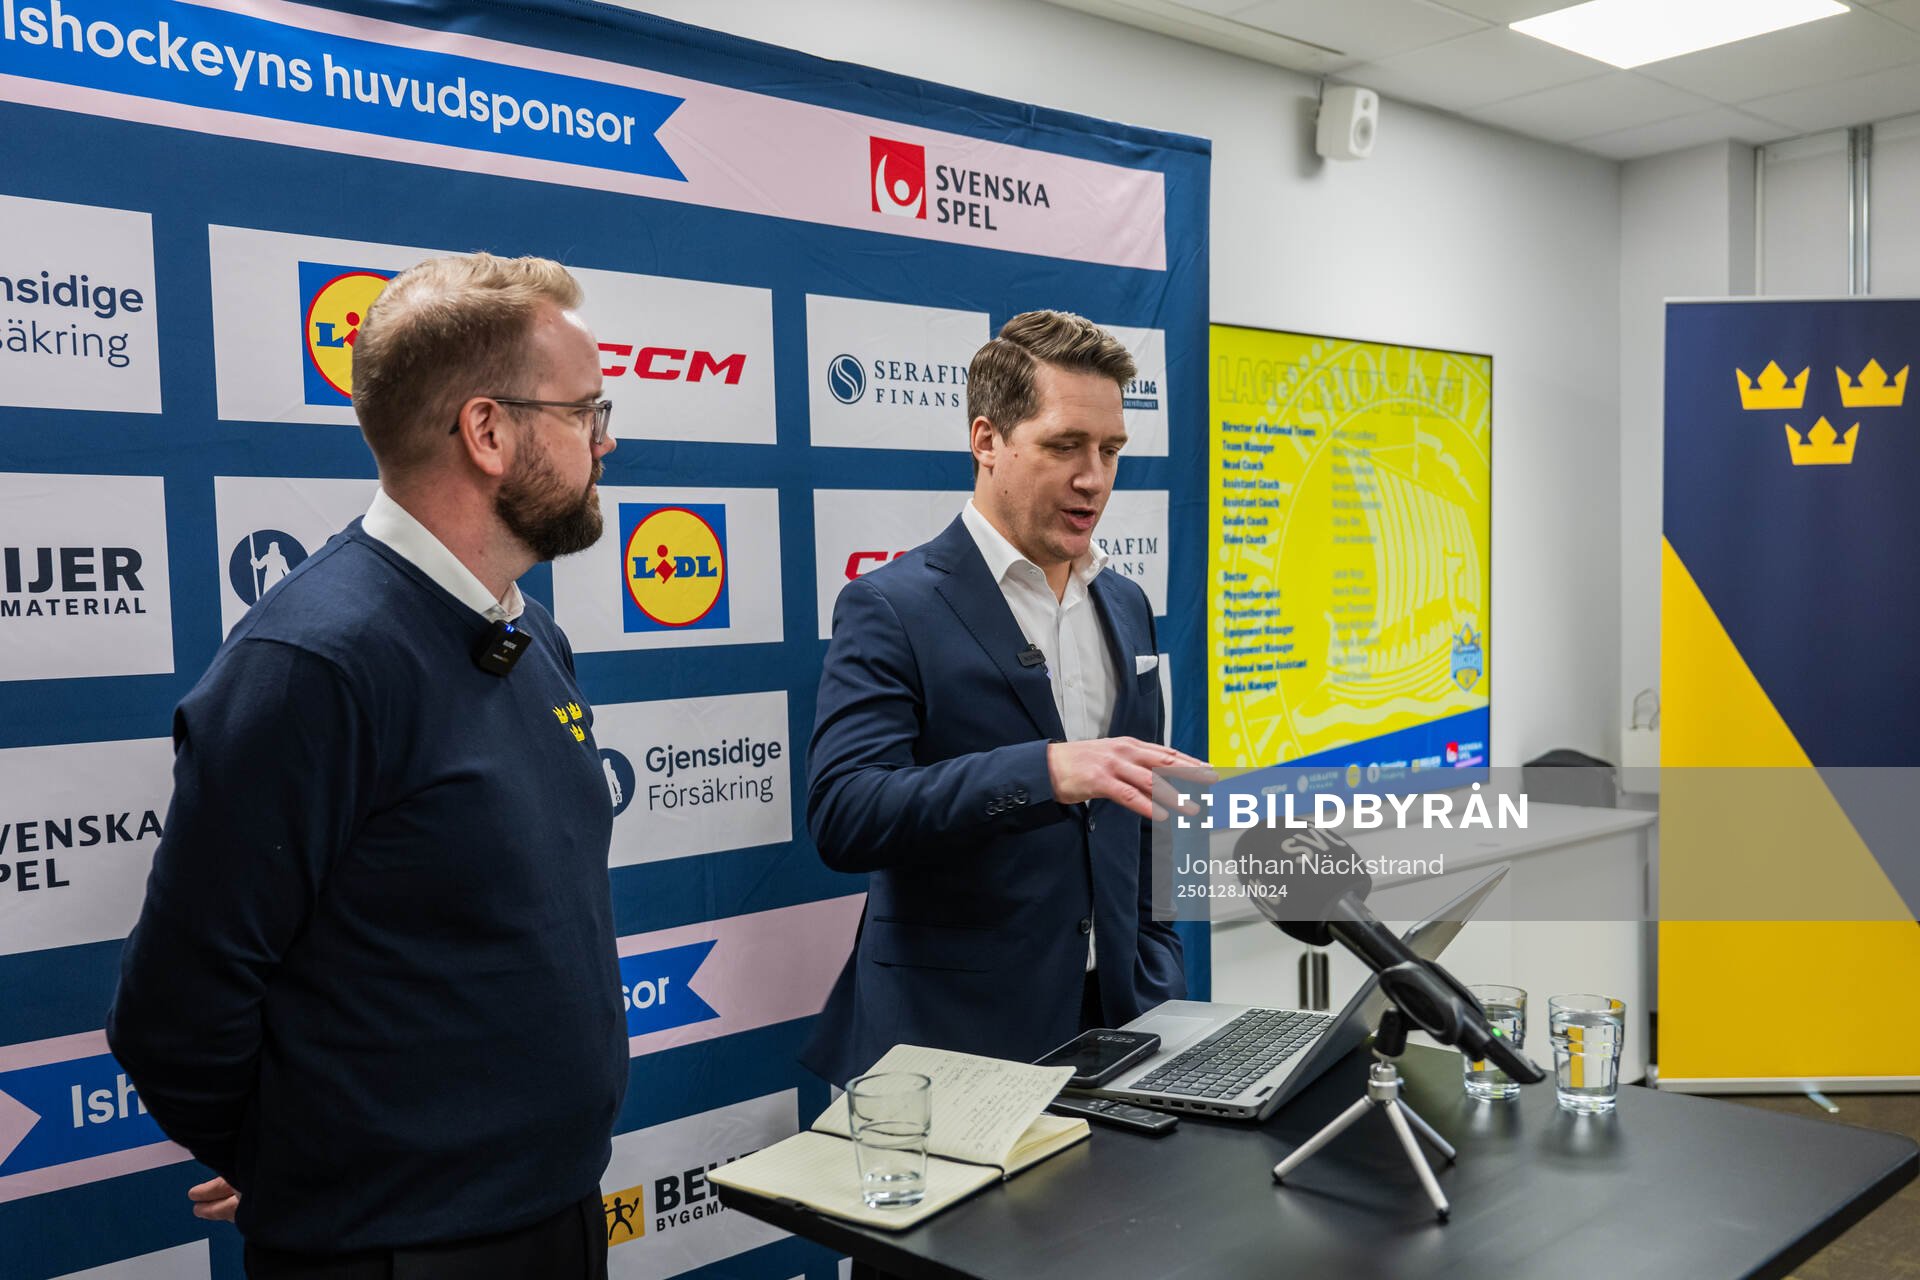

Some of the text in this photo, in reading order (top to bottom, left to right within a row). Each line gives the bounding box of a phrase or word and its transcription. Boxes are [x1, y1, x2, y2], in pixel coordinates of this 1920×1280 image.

[3, 0, 636, 146] Ishockeyns huvudsponsor
[936, 164, 1050, 208] SVENSKA
[937, 197, 998, 231] SPEL
[0, 318, 130, 368] äkring
[1139, 380, 1157, 395] LAG
[876, 388, 960, 408] FINANS
[1222, 421, 1252, 433] Director
[1294, 425, 1316, 437] Teams
[1223, 440, 1274, 455] Team Manager
[1223, 459, 1264, 471] Head Coach
[1223, 478, 1280, 490] Assistant Coach
[1223, 496, 1280, 508] Assistant Coach
[1247, 516, 1268, 526] Coach
[1097, 537, 1158, 556] RAFIM
[1223, 533, 1267, 544] Video Coach
[4, 547, 145, 593] IJER
[1224, 571, 1248, 582] Doctor
[0, 597, 146, 617] MATERIAL
[1264, 625, 1294, 636] Manager
[1264, 643, 1294, 654] Manager
[1225, 680, 1277, 693] Media Manager
[645, 736, 782, 778] Gjensidige
[648, 775, 774, 811] Försäkring
[71, 1073, 148, 1129] Ish
